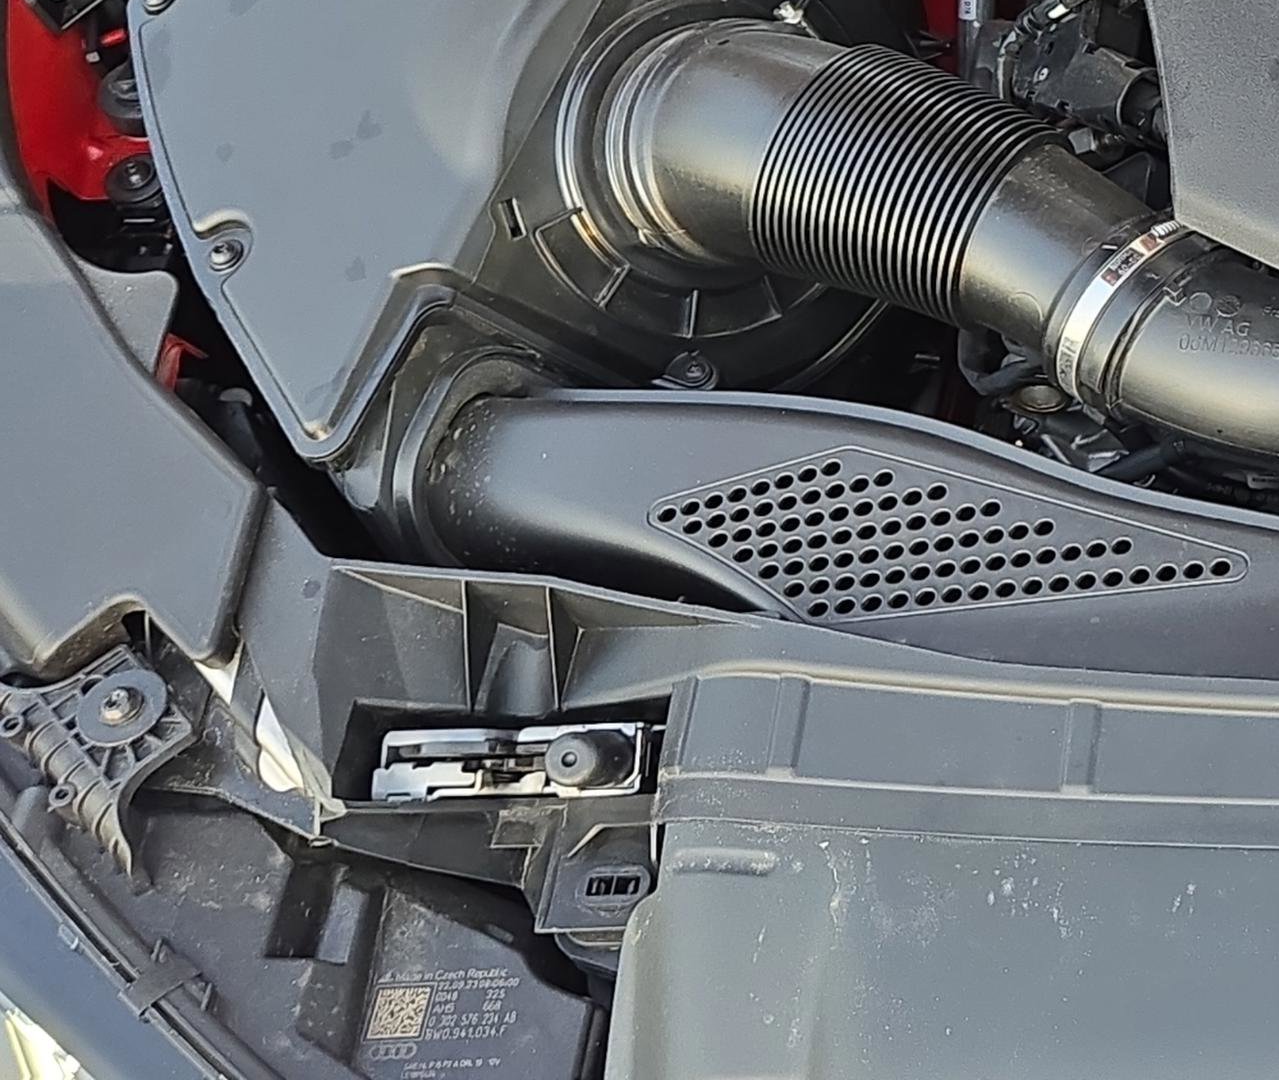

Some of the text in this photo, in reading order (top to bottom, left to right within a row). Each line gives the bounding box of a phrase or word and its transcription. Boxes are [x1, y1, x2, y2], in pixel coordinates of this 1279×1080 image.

[1220, 319, 1252, 337] AG
[435, 969, 466, 981] Czech
[467, 967, 509, 979] Republic
